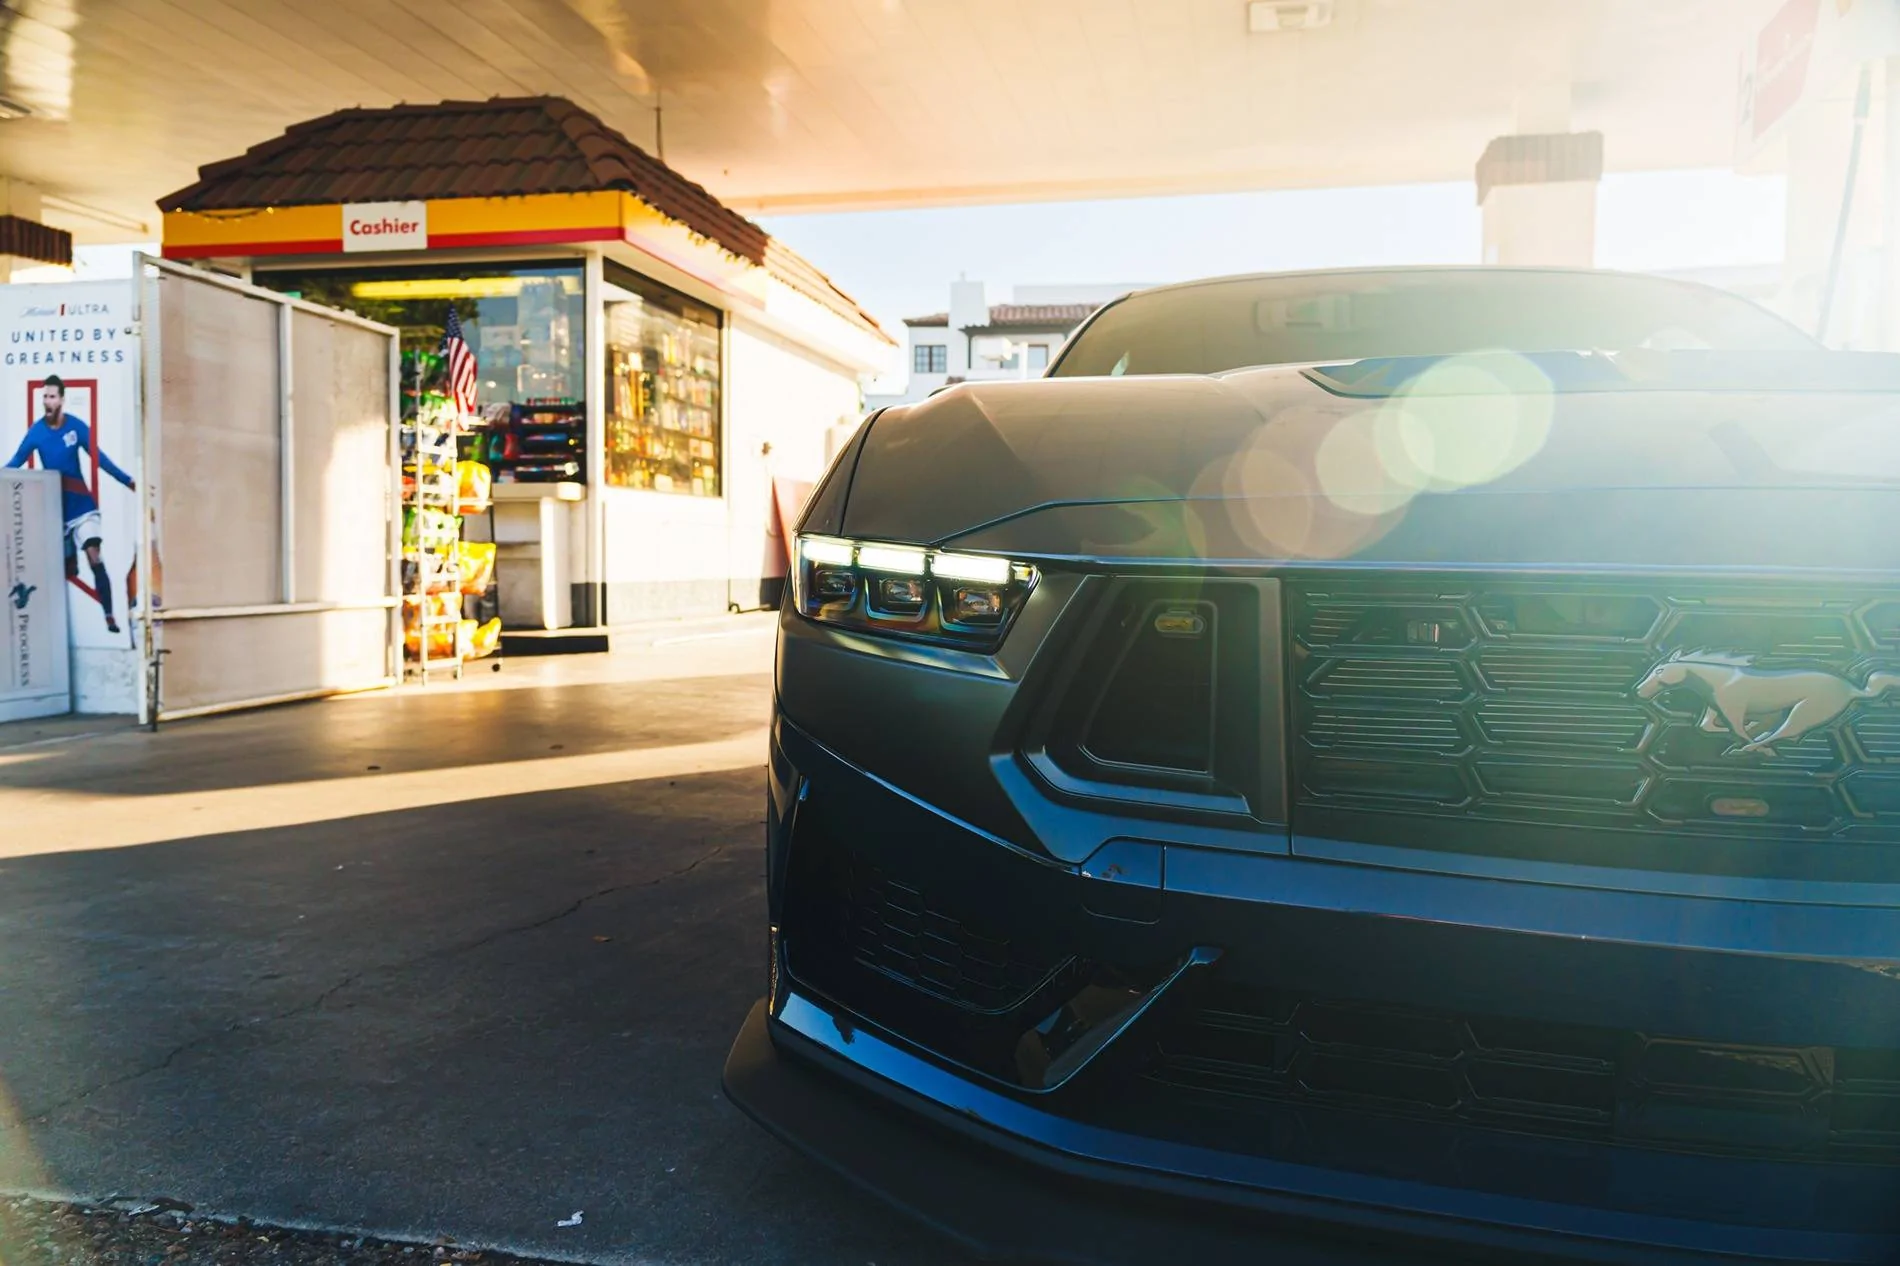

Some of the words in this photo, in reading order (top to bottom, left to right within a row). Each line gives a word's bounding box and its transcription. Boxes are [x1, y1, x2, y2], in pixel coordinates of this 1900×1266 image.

[350, 217, 419, 235] Cashier
[68, 303, 110, 316] ULTRA
[11, 328, 84, 343] UNITED
[93, 328, 116, 341] BY
[5, 350, 124, 365] GREATNESS
[17, 613, 30, 688] PROGRESS
